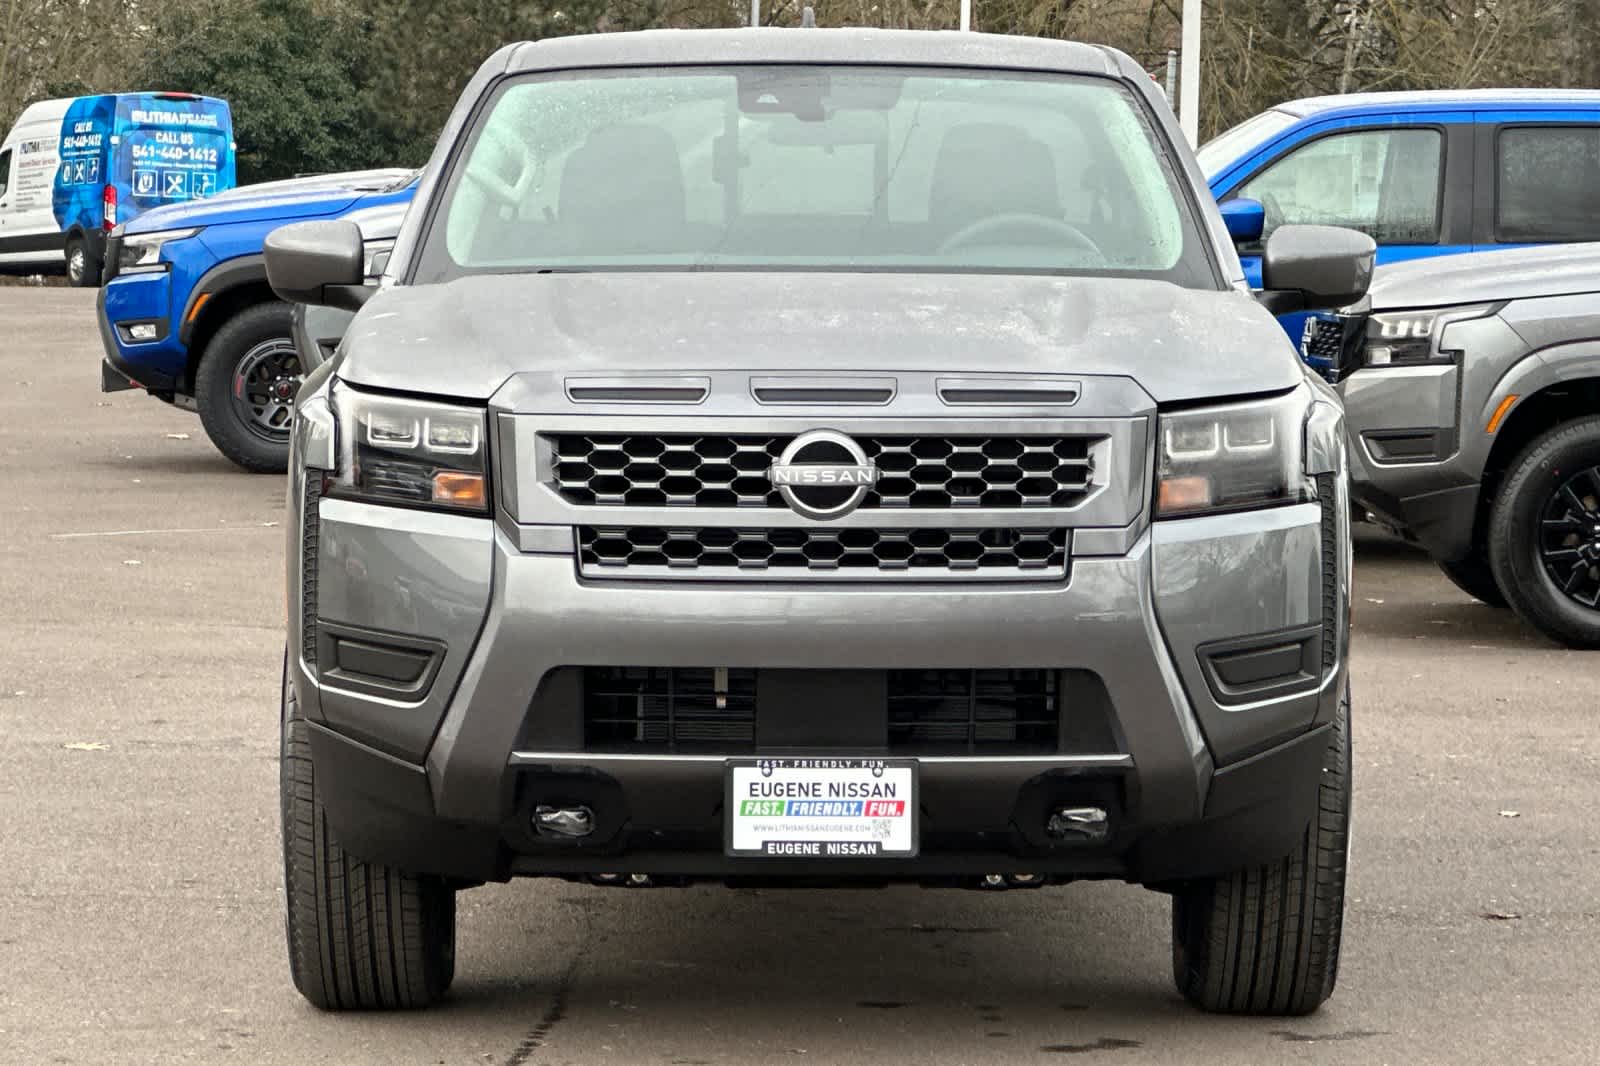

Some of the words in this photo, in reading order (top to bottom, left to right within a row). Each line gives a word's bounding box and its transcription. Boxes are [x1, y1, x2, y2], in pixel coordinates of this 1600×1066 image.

[74, 122, 85, 133] CALL
[64, 134, 102, 148] 541-440-1412
[156, 131, 179, 144] CALL
[180, 132, 194, 145] US
[132, 145, 217, 162] 541-440-1412
[775, 470, 873, 482] NISSAN
[756, 760, 790, 768] FAST.
[794, 760, 857, 768] FRIENDLY.
[862, 760, 889, 768] FUN.
[749, 782, 822, 797] EUGENE
[828, 782, 896, 797] NISSAN
[744, 802, 781, 816] FAST.
[792, 802, 860, 816] FRIENDLY.
[869, 802, 902, 816] FUN.
[767, 843, 820, 854] EUGENE
[827, 843, 877, 854] NISSAN
